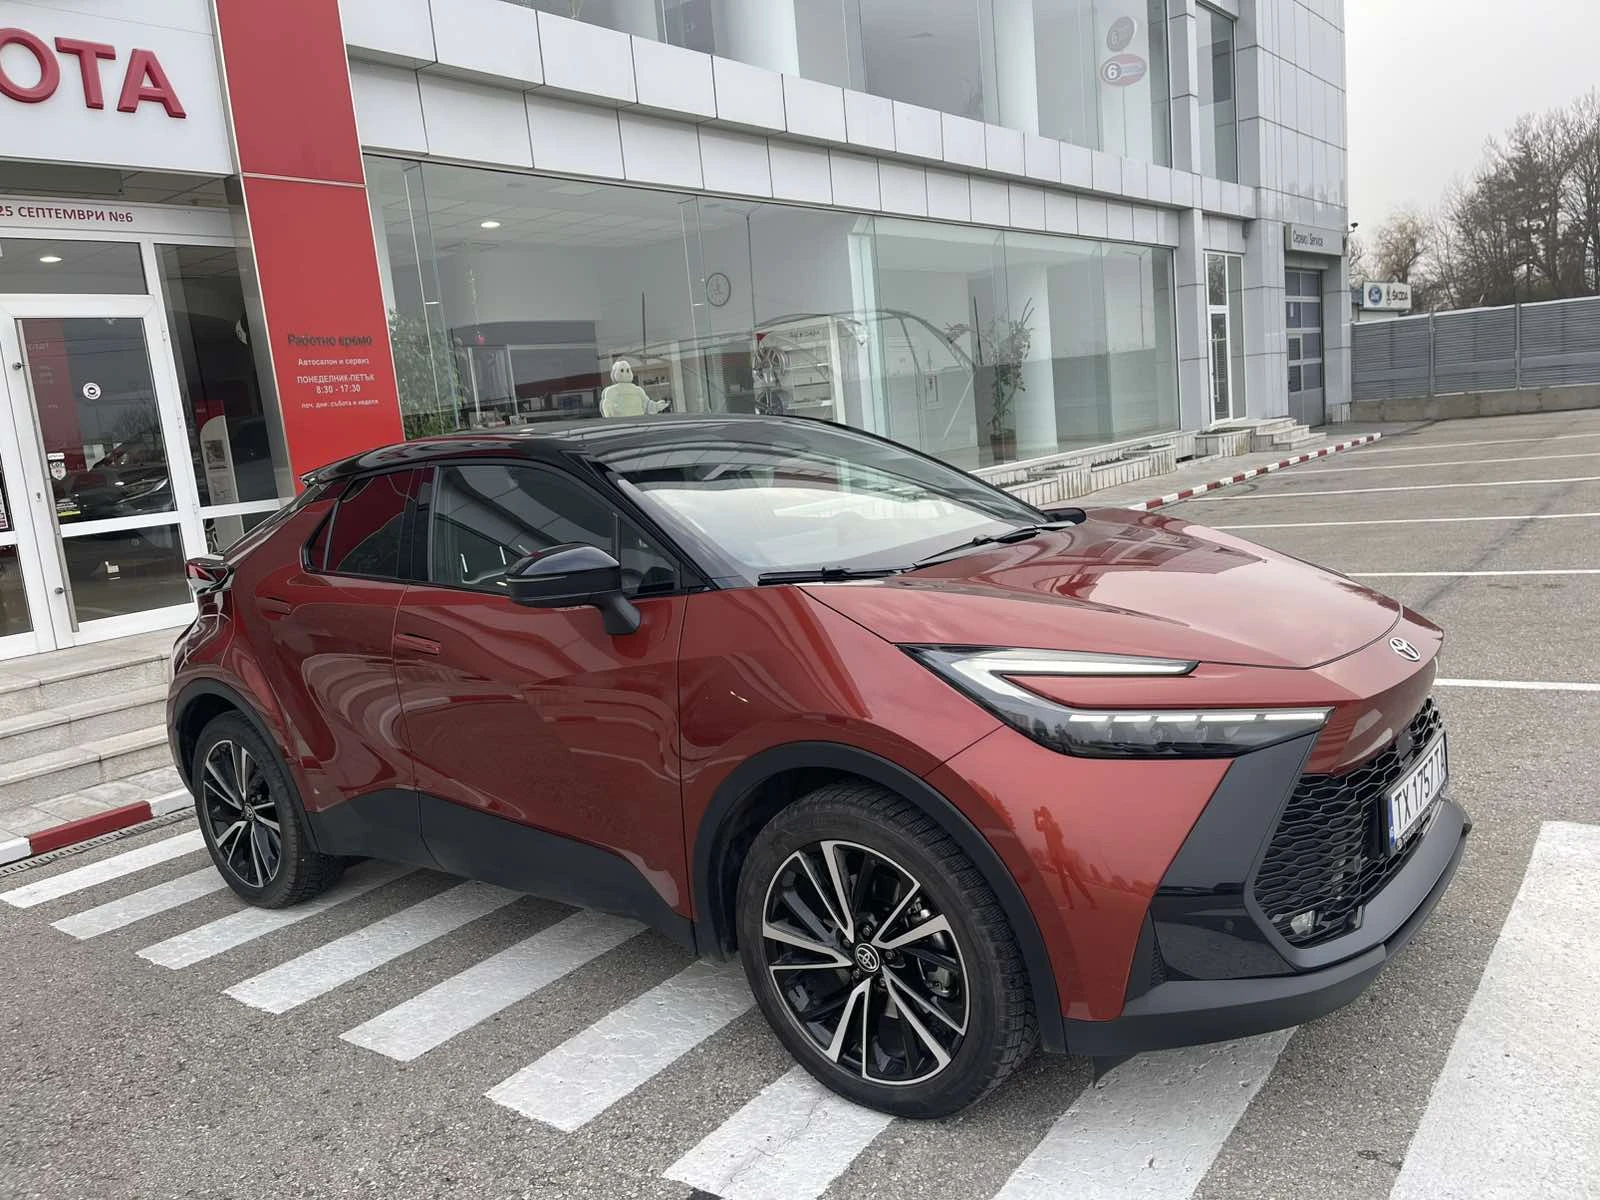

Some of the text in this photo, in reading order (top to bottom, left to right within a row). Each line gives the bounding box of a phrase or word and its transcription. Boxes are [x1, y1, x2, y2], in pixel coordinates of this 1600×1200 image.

[0, 205, 134, 223] 25 СЕПТЕМВРИ №6
[288, 334, 336, 346] Работно
[298, 358, 338, 366] Автосалон
[316, 385, 333, 394] 8:30
[340, 384, 360, 393] 17:30
[1413, 756, 1433, 811] 1757
